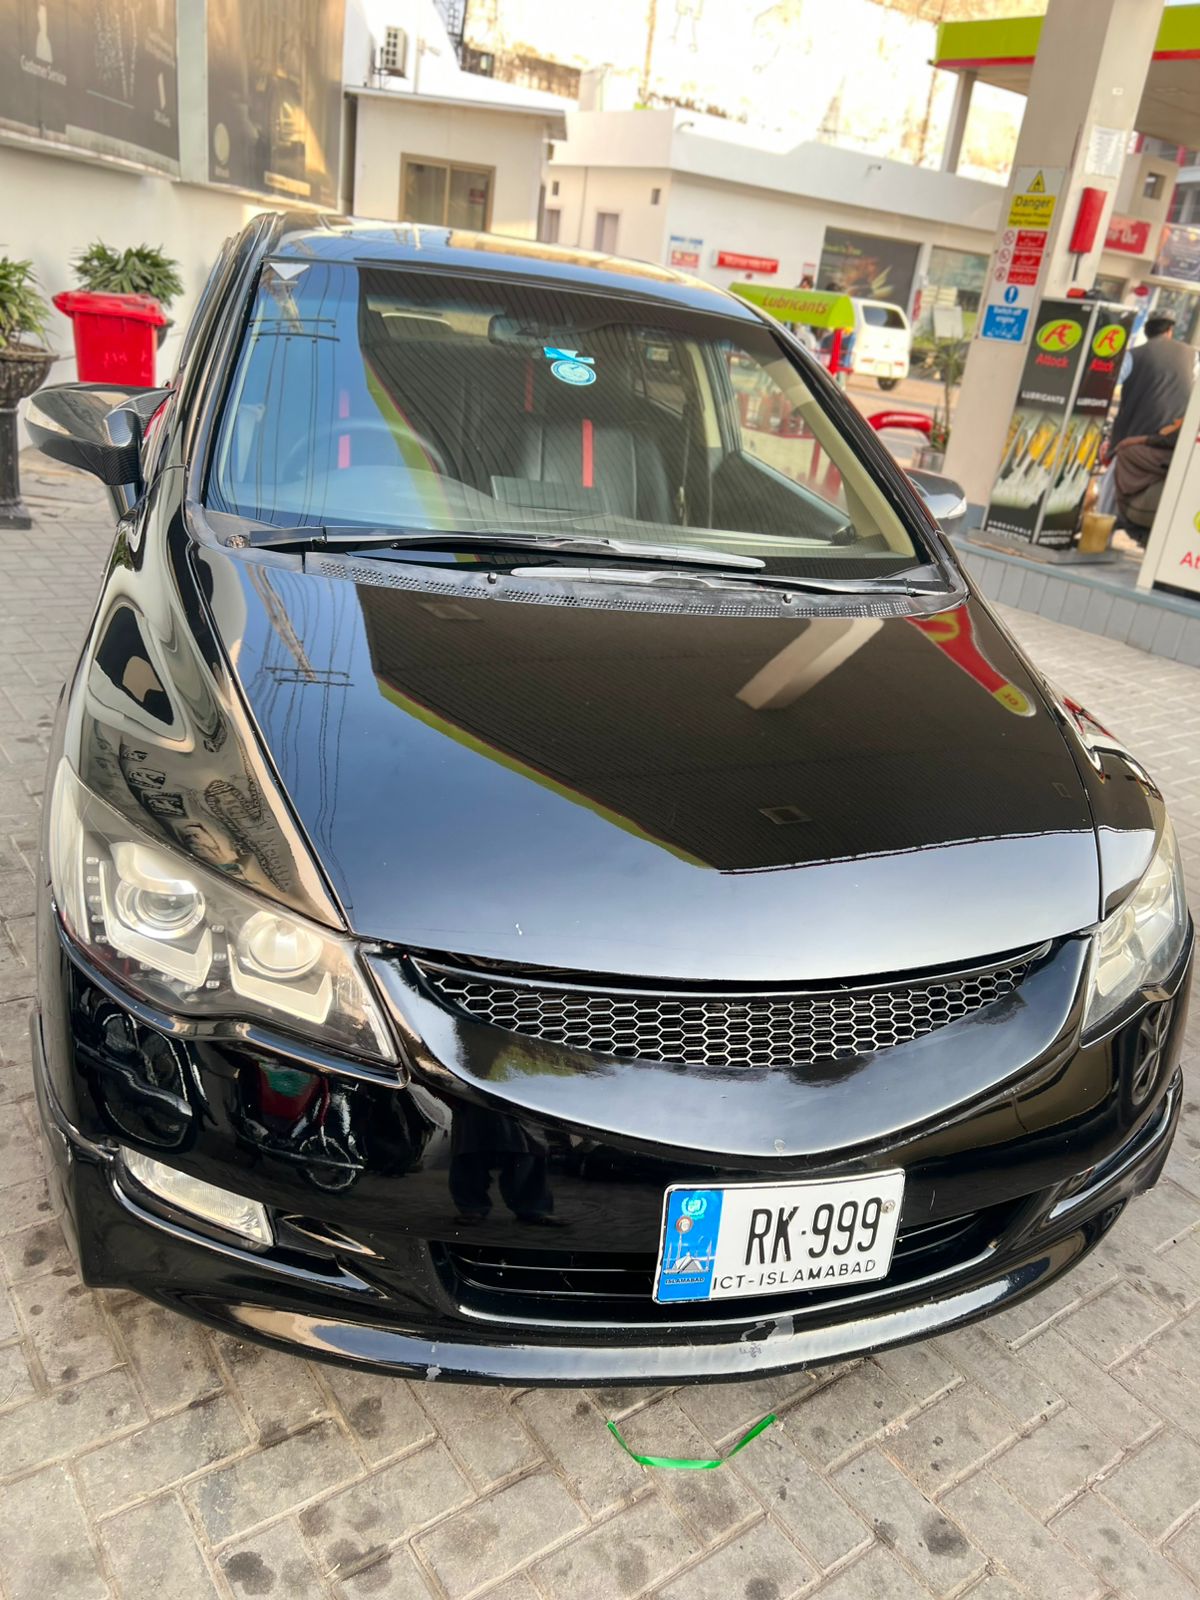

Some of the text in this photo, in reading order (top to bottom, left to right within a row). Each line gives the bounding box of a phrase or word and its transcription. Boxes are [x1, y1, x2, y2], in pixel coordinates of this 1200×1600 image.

[1015, 196, 1051, 210] Danger
[762, 293, 829, 315] Lubricants
[1035, 353, 1069, 369] Attock
[1021, 390, 1065, 405] LUBRICANTS
[664, 1276, 706, 1286] ISLAMABAD
[712, 1258, 877, 1291] ICT-ISLAMABAD
